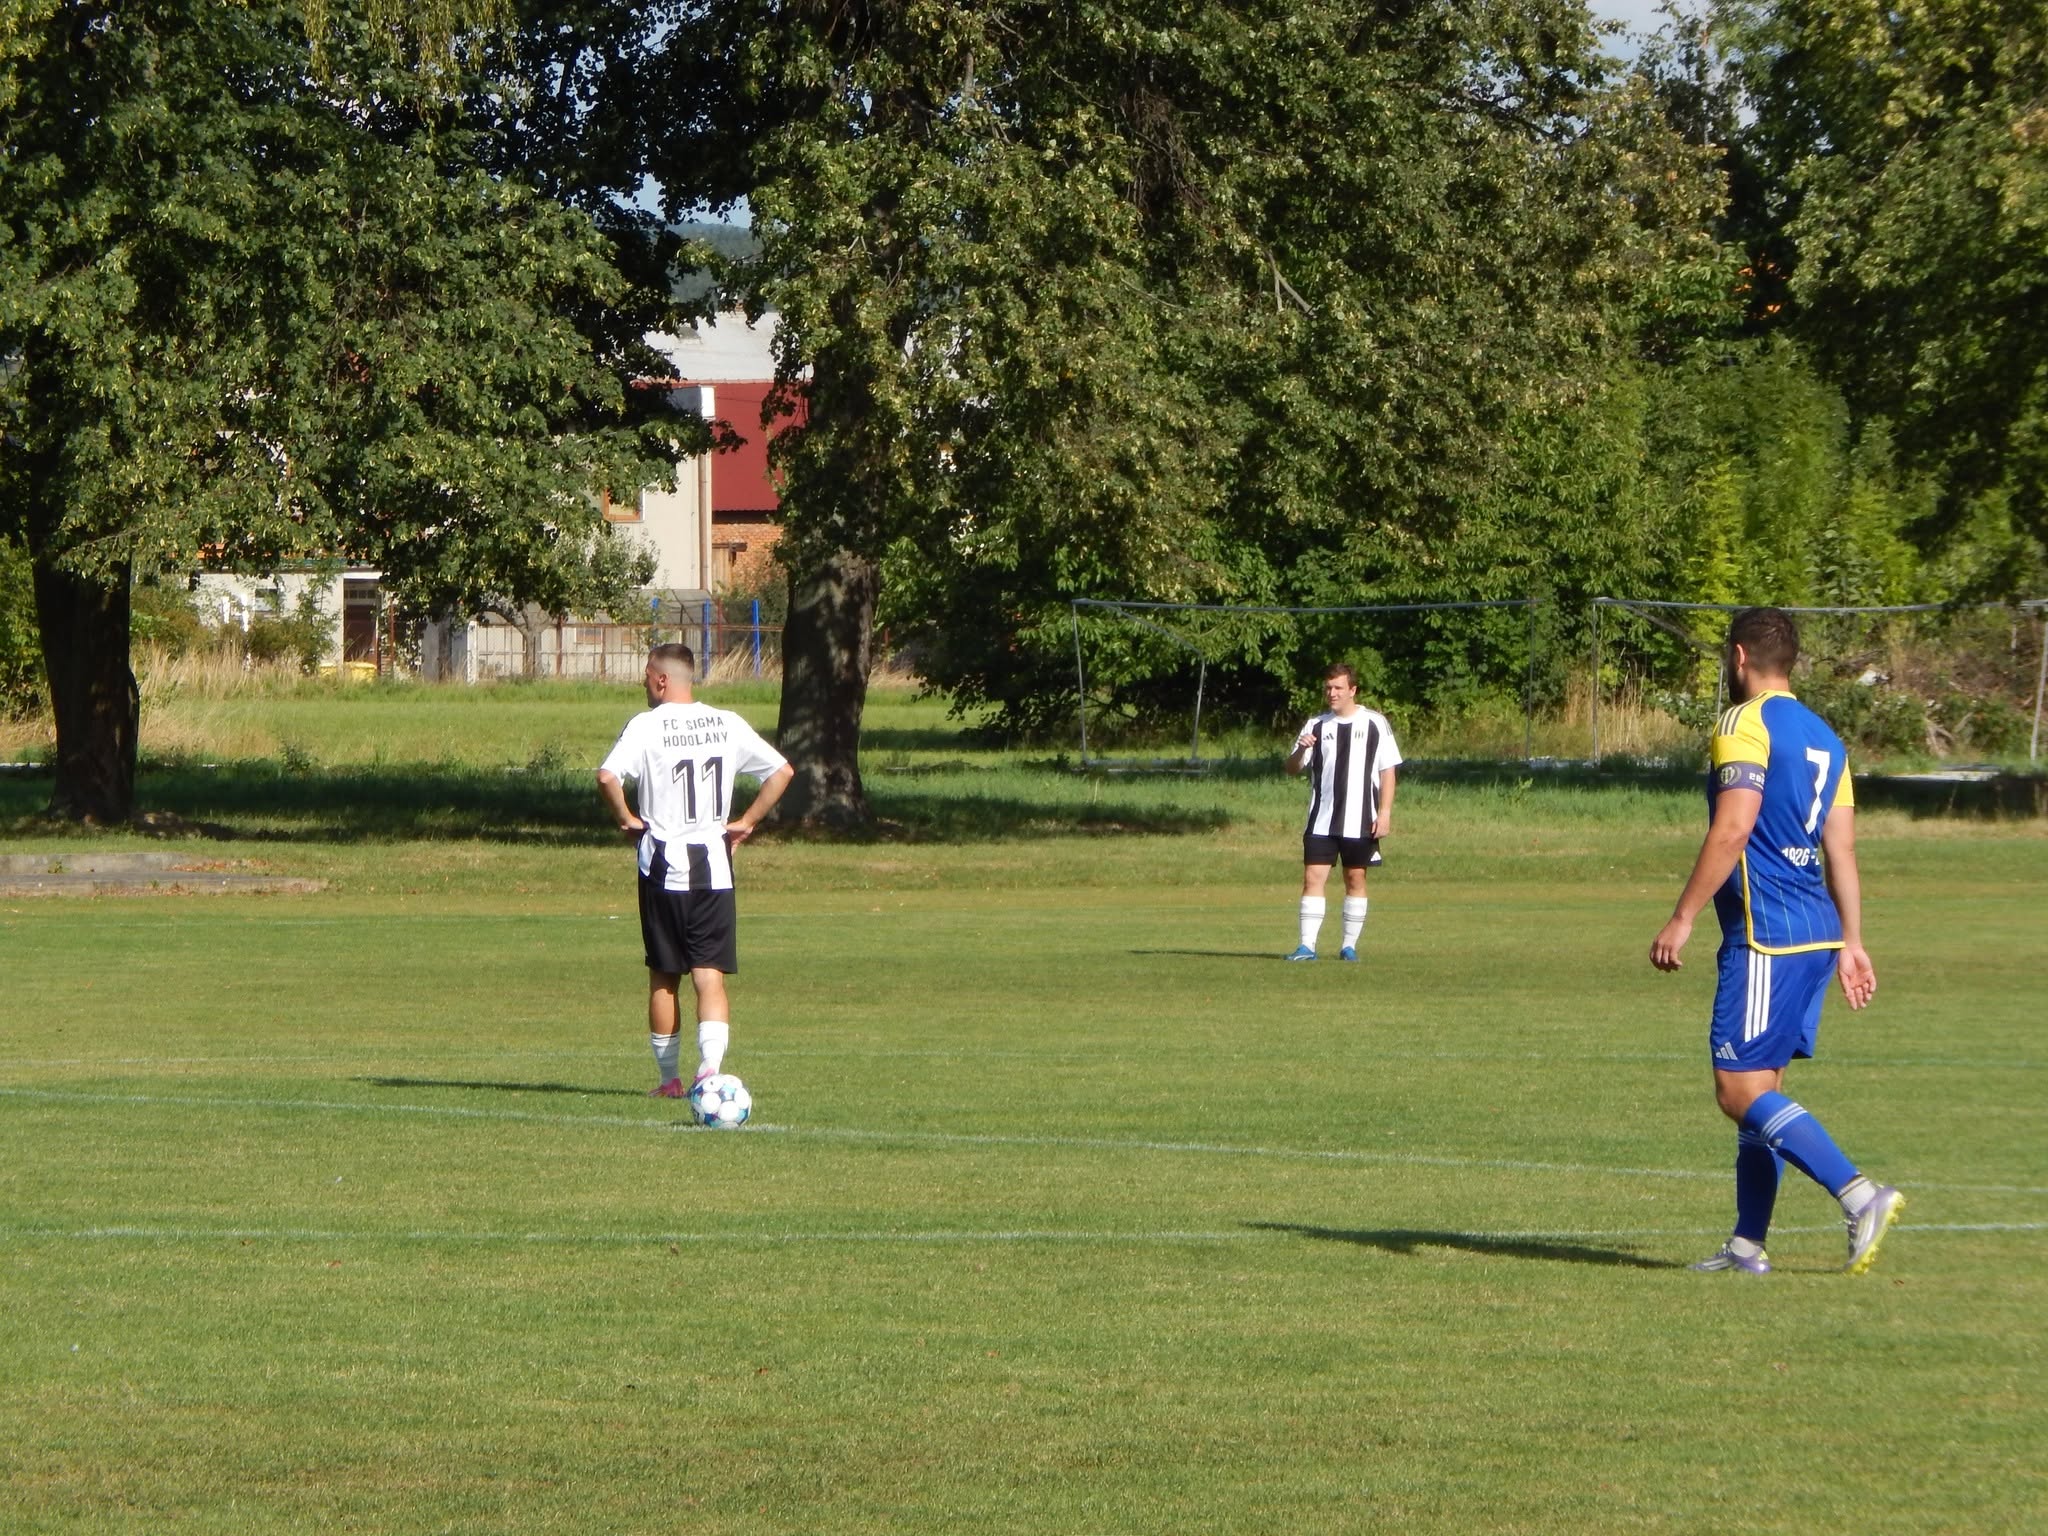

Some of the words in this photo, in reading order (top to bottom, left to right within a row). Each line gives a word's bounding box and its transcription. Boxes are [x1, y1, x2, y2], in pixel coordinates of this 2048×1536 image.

[663, 719, 679, 731] FC
[686, 716, 724, 731] SIGMA
[663, 731, 728, 748] HODOLANY
[672, 756, 723, 824] 11
[1804, 746, 1831, 835] 7
